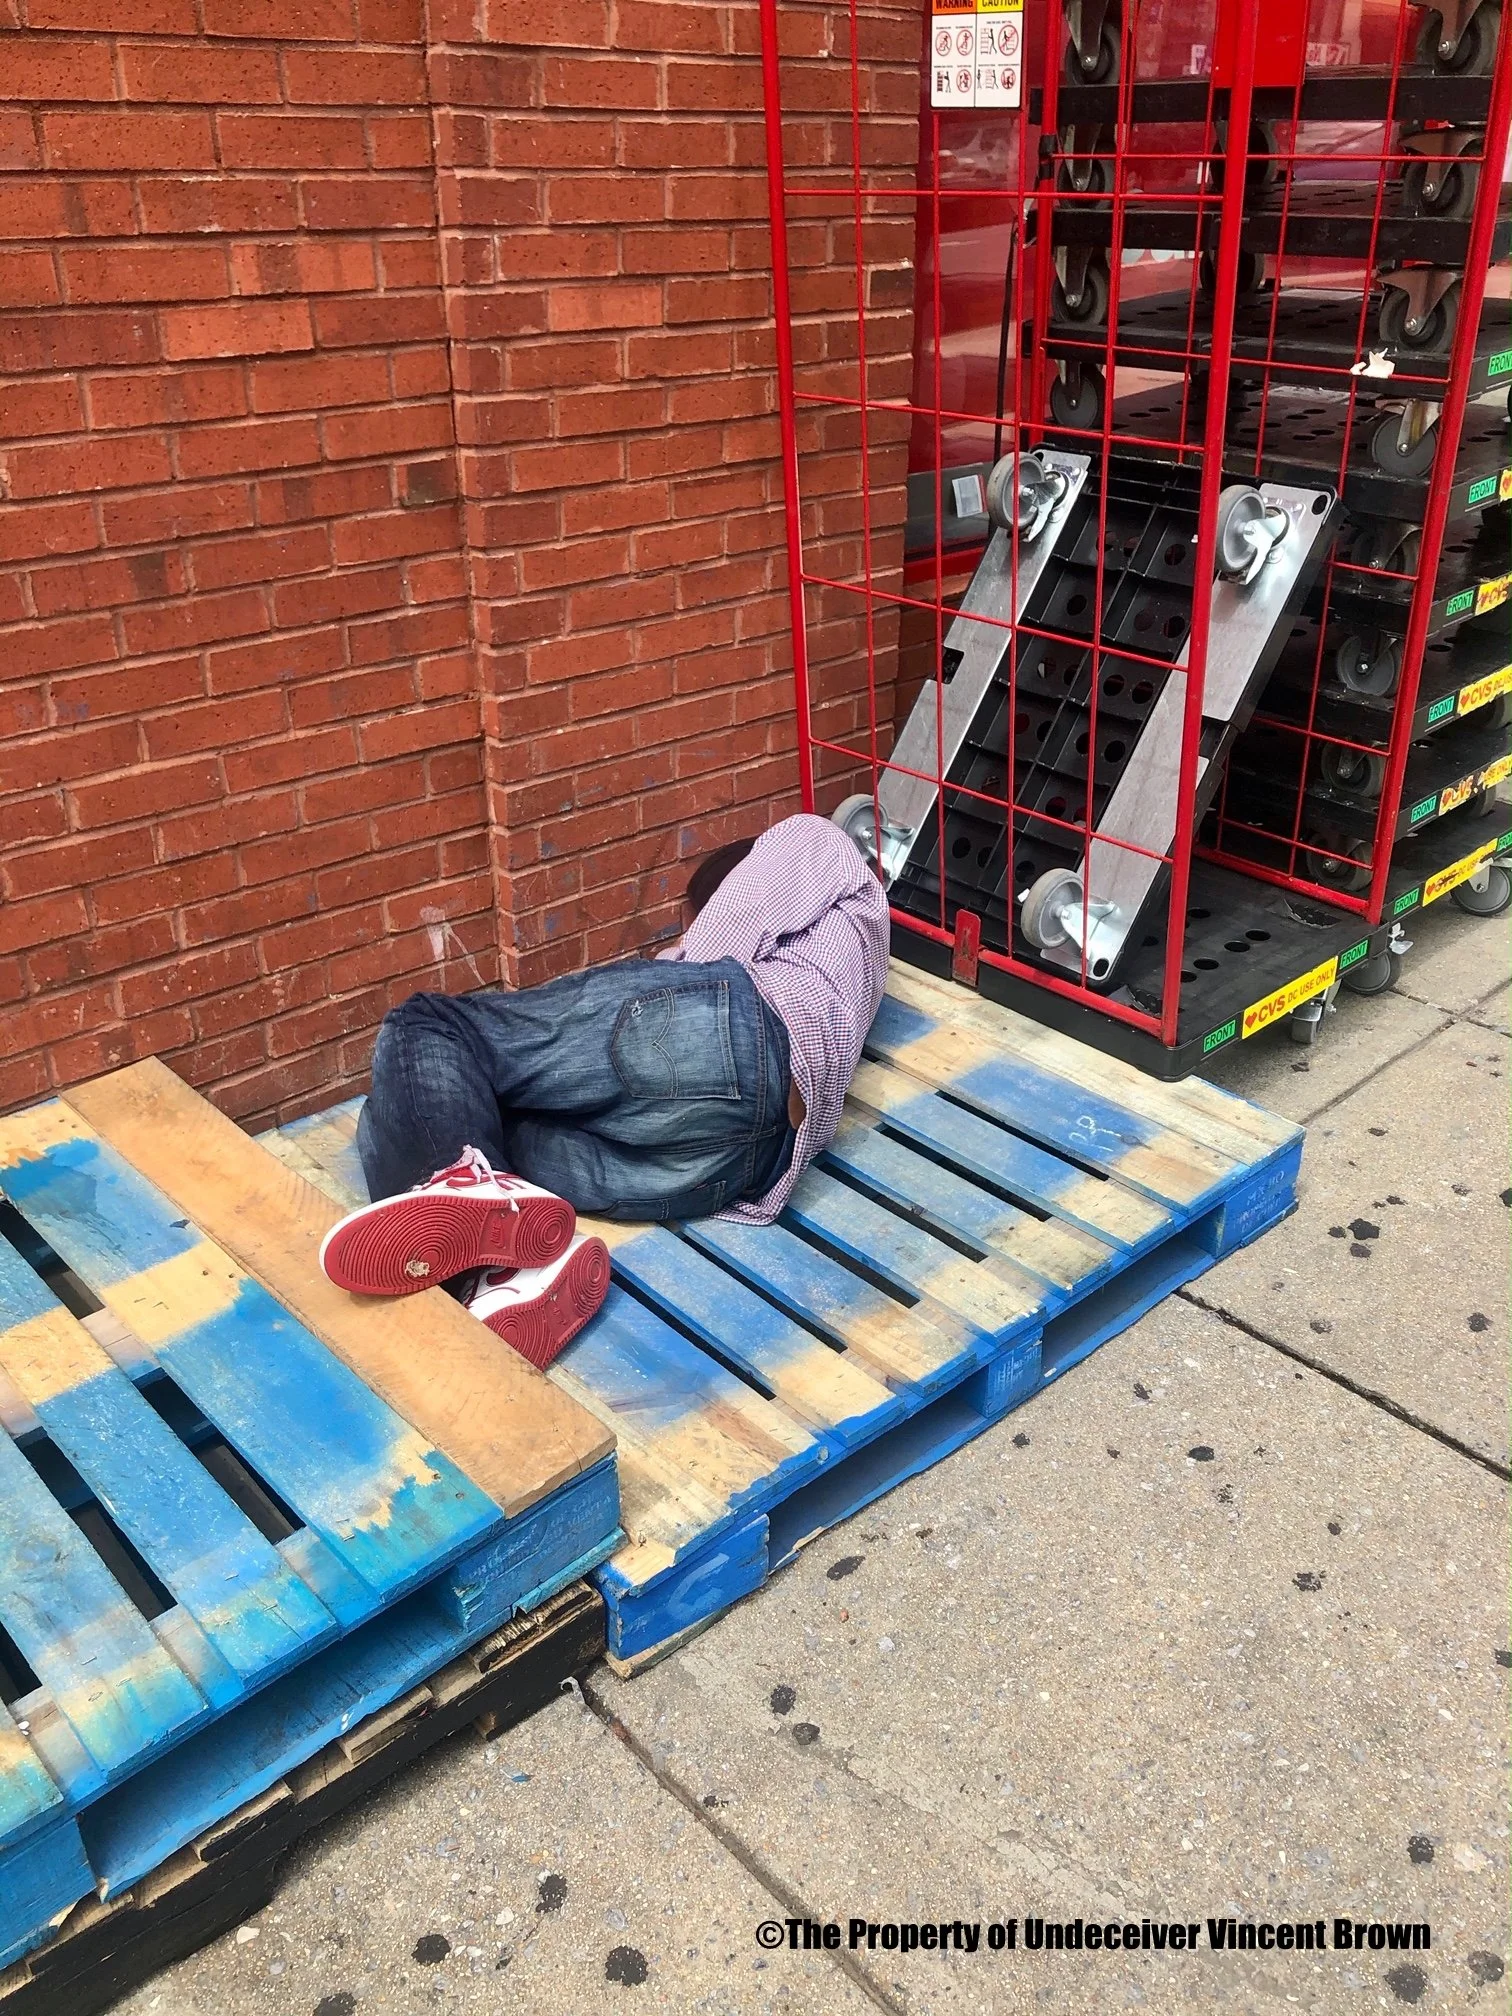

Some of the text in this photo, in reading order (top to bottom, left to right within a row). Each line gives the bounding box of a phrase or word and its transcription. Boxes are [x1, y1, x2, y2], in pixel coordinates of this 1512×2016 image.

[1471, 477, 1496, 501] FRONT
[1448, 591, 1473, 614] FRONT
[1471, 680, 1493, 705] CVS
[1430, 697, 1454, 720] FRONT
[1413, 796, 1437, 820] FRONT
[1395, 890, 1419, 913] FRONT
[1341, 941, 1368, 968] FRONT
[1258, 966, 1336, 1023] CVS DC USE ONLY
[1204, 1022, 1235, 1050] FRONT
